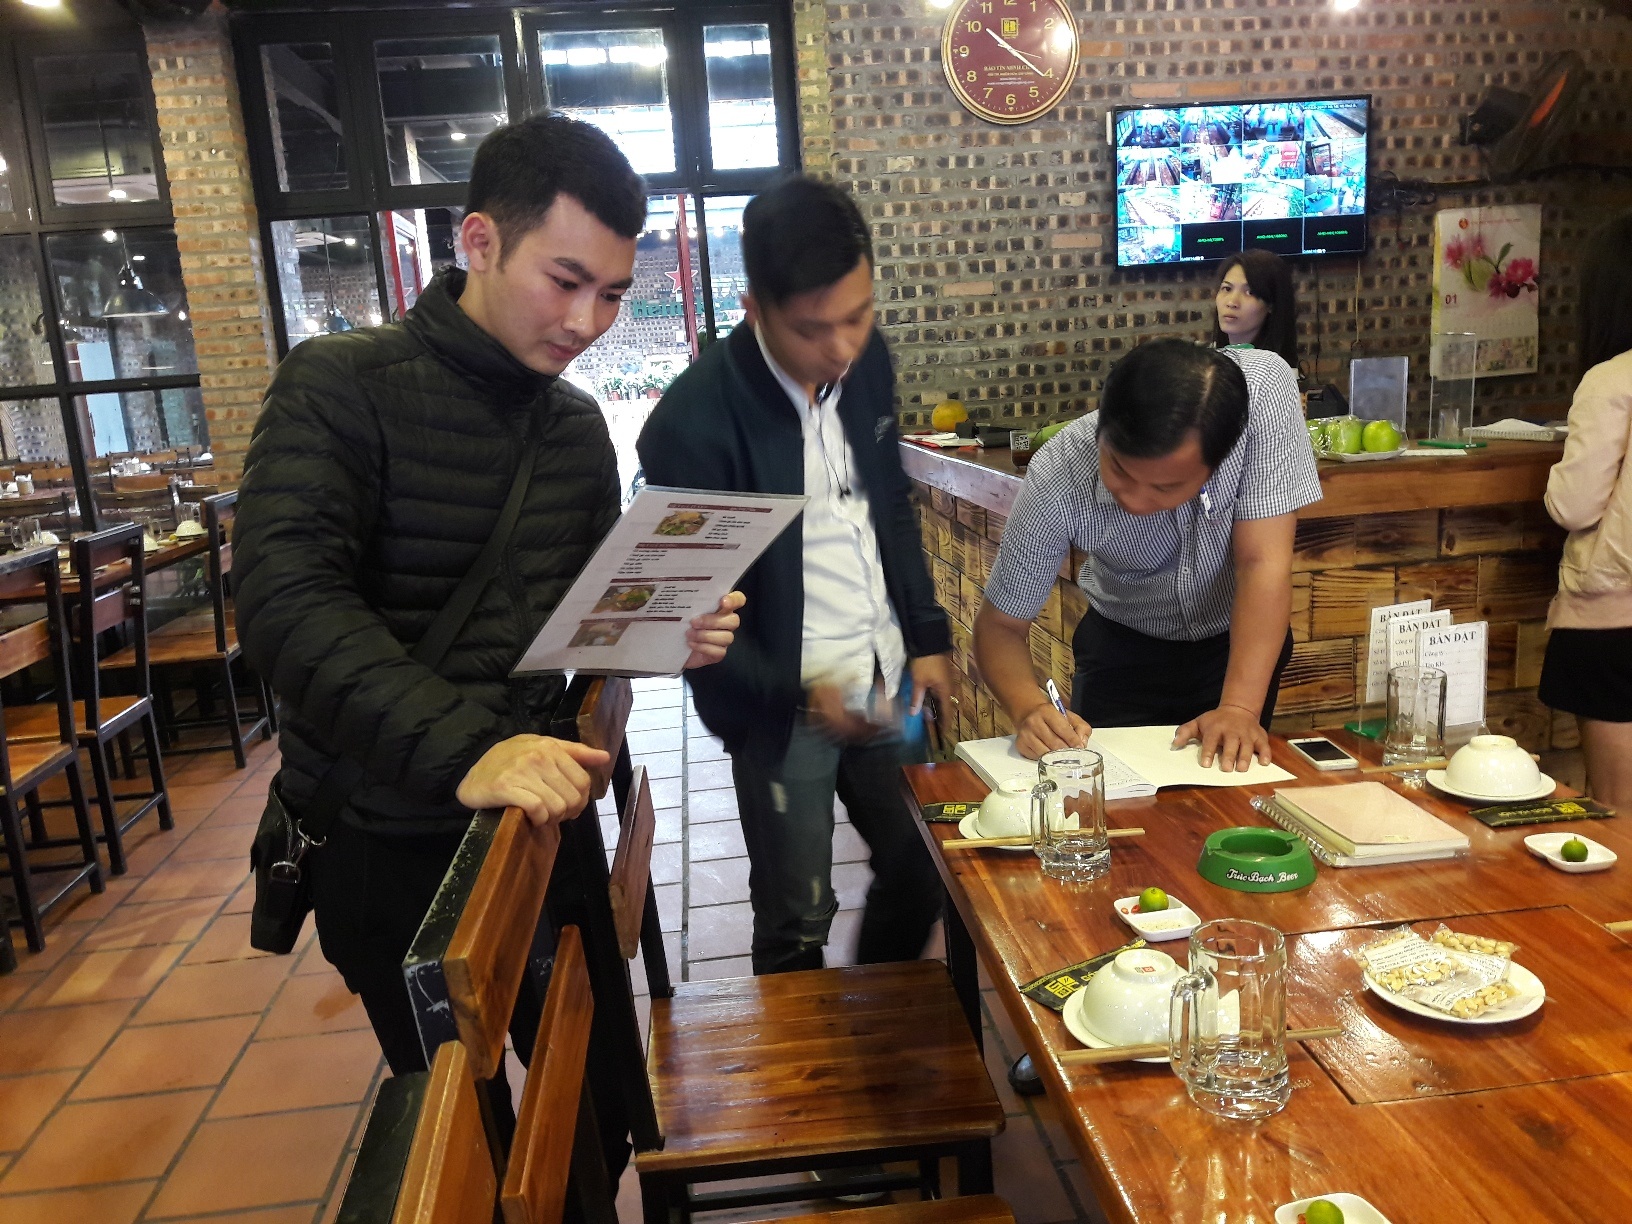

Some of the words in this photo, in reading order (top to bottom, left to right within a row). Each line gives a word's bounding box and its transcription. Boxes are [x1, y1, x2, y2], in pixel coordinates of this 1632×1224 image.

[980, 2, 992, 14] 11
[1030, 1, 1036, 12] 1
[965, 20, 982, 32] 10
[1044, 18, 1054, 29] 2
[959, 45, 970, 57] 9
[967, 70, 977, 82] 8
[1044, 68, 1054, 79] 4
[983, 87, 994, 99] 7
[1029, 87, 1039, 98] 5
[1005, 94, 1016, 106] 6
[1445, 293, 1457, 305] 01
[1276, 871, 1299, 883] Beer
